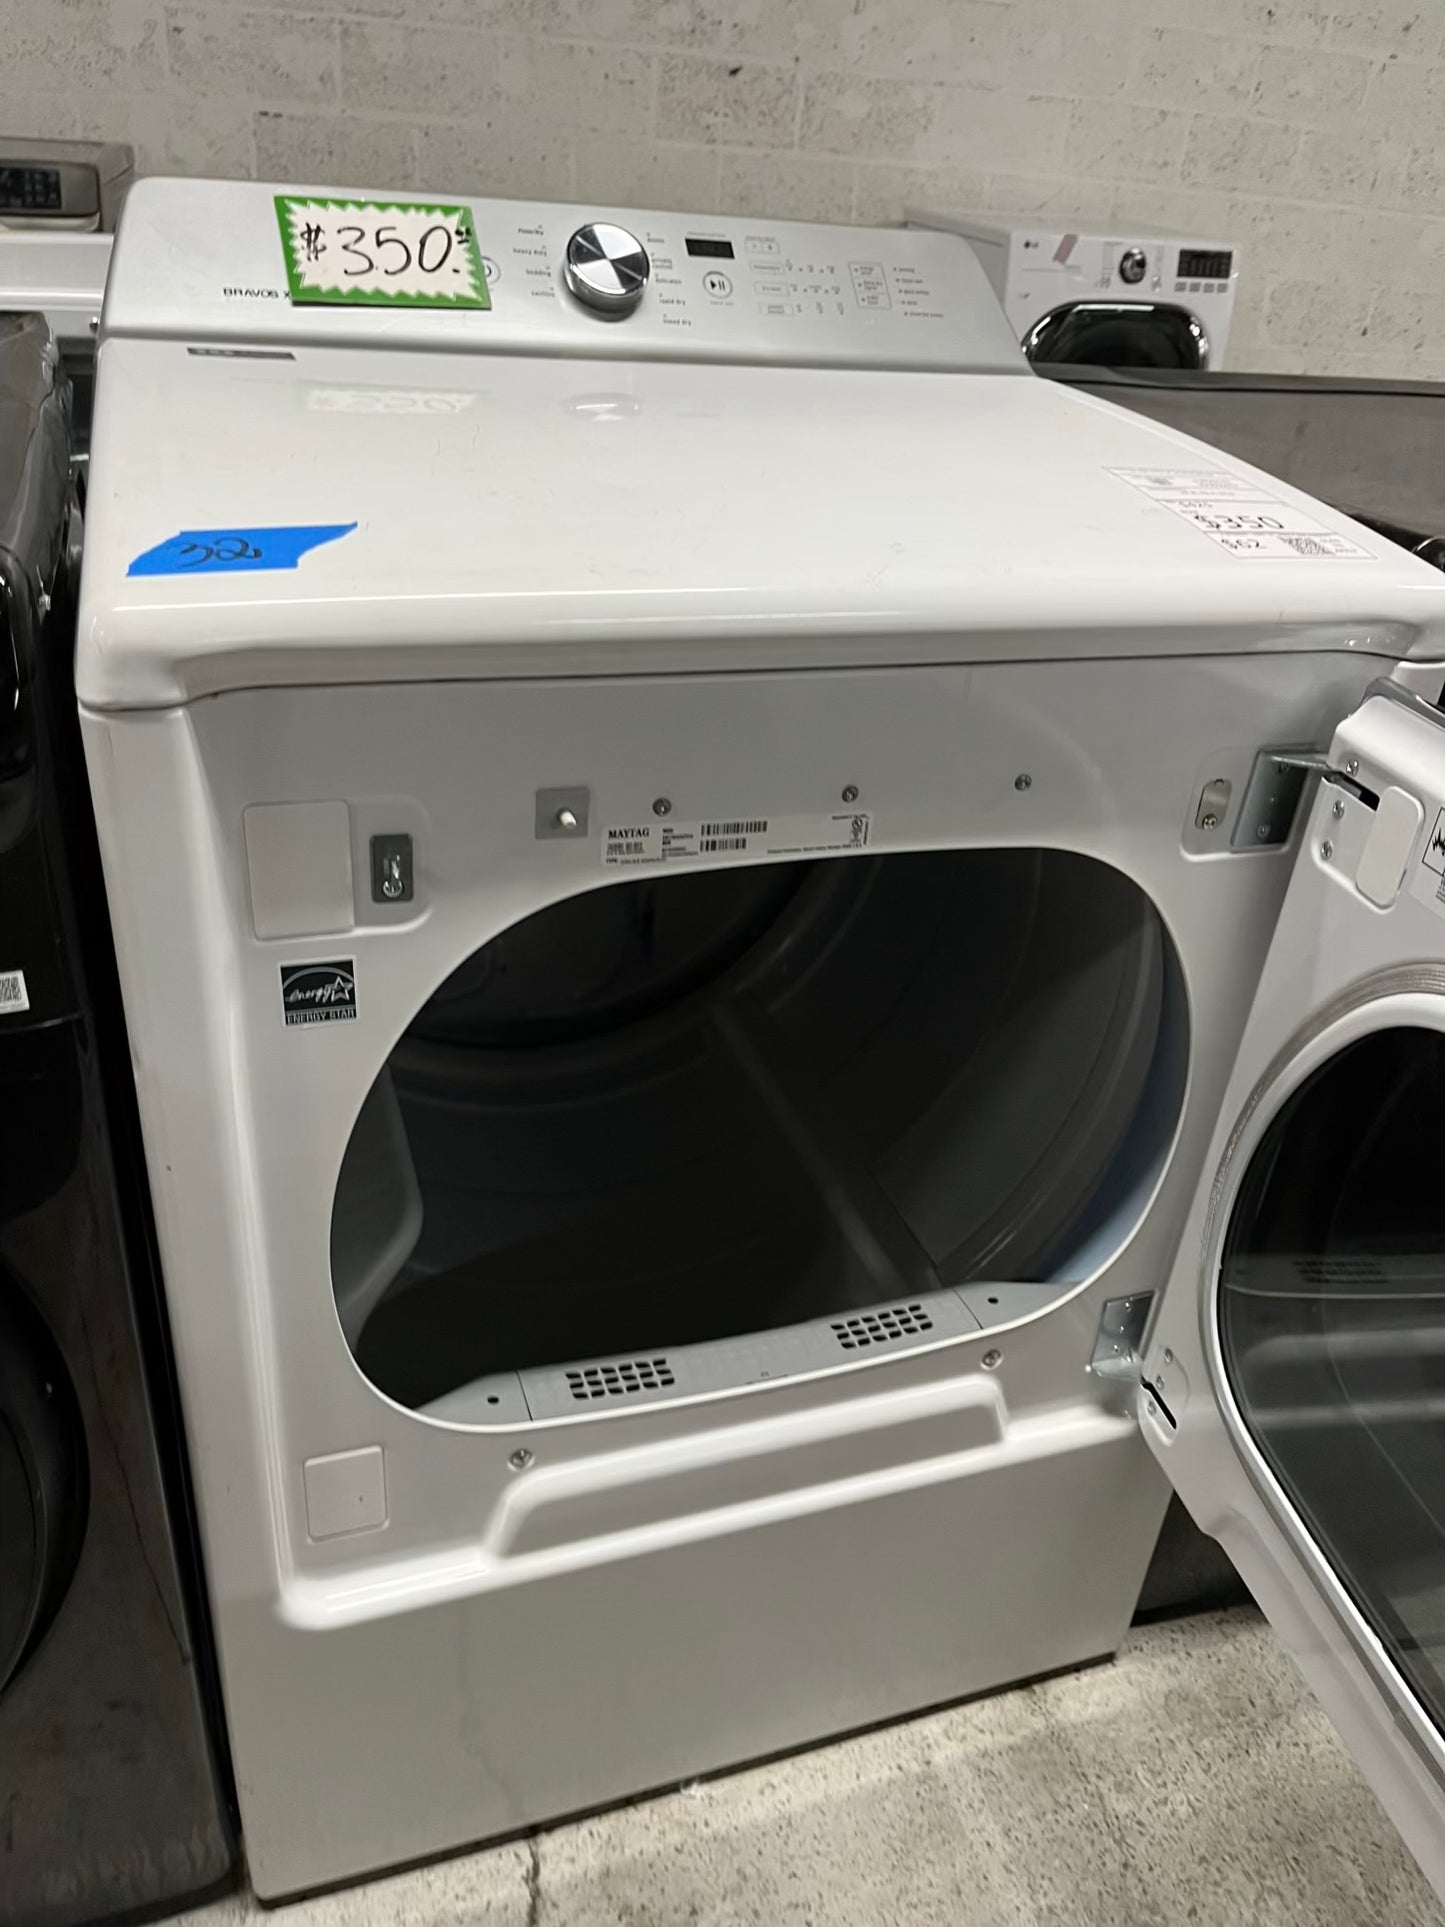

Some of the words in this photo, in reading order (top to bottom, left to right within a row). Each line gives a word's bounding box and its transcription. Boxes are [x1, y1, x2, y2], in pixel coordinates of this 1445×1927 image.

[222, 287, 280, 299] BRAVOS
[1194, 515, 1284, 531] $350
[608, 827, 650, 840] MAYTAG
[287, 1011, 326, 1025] ENERGY
[329, 1007, 355, 1019] STAR
